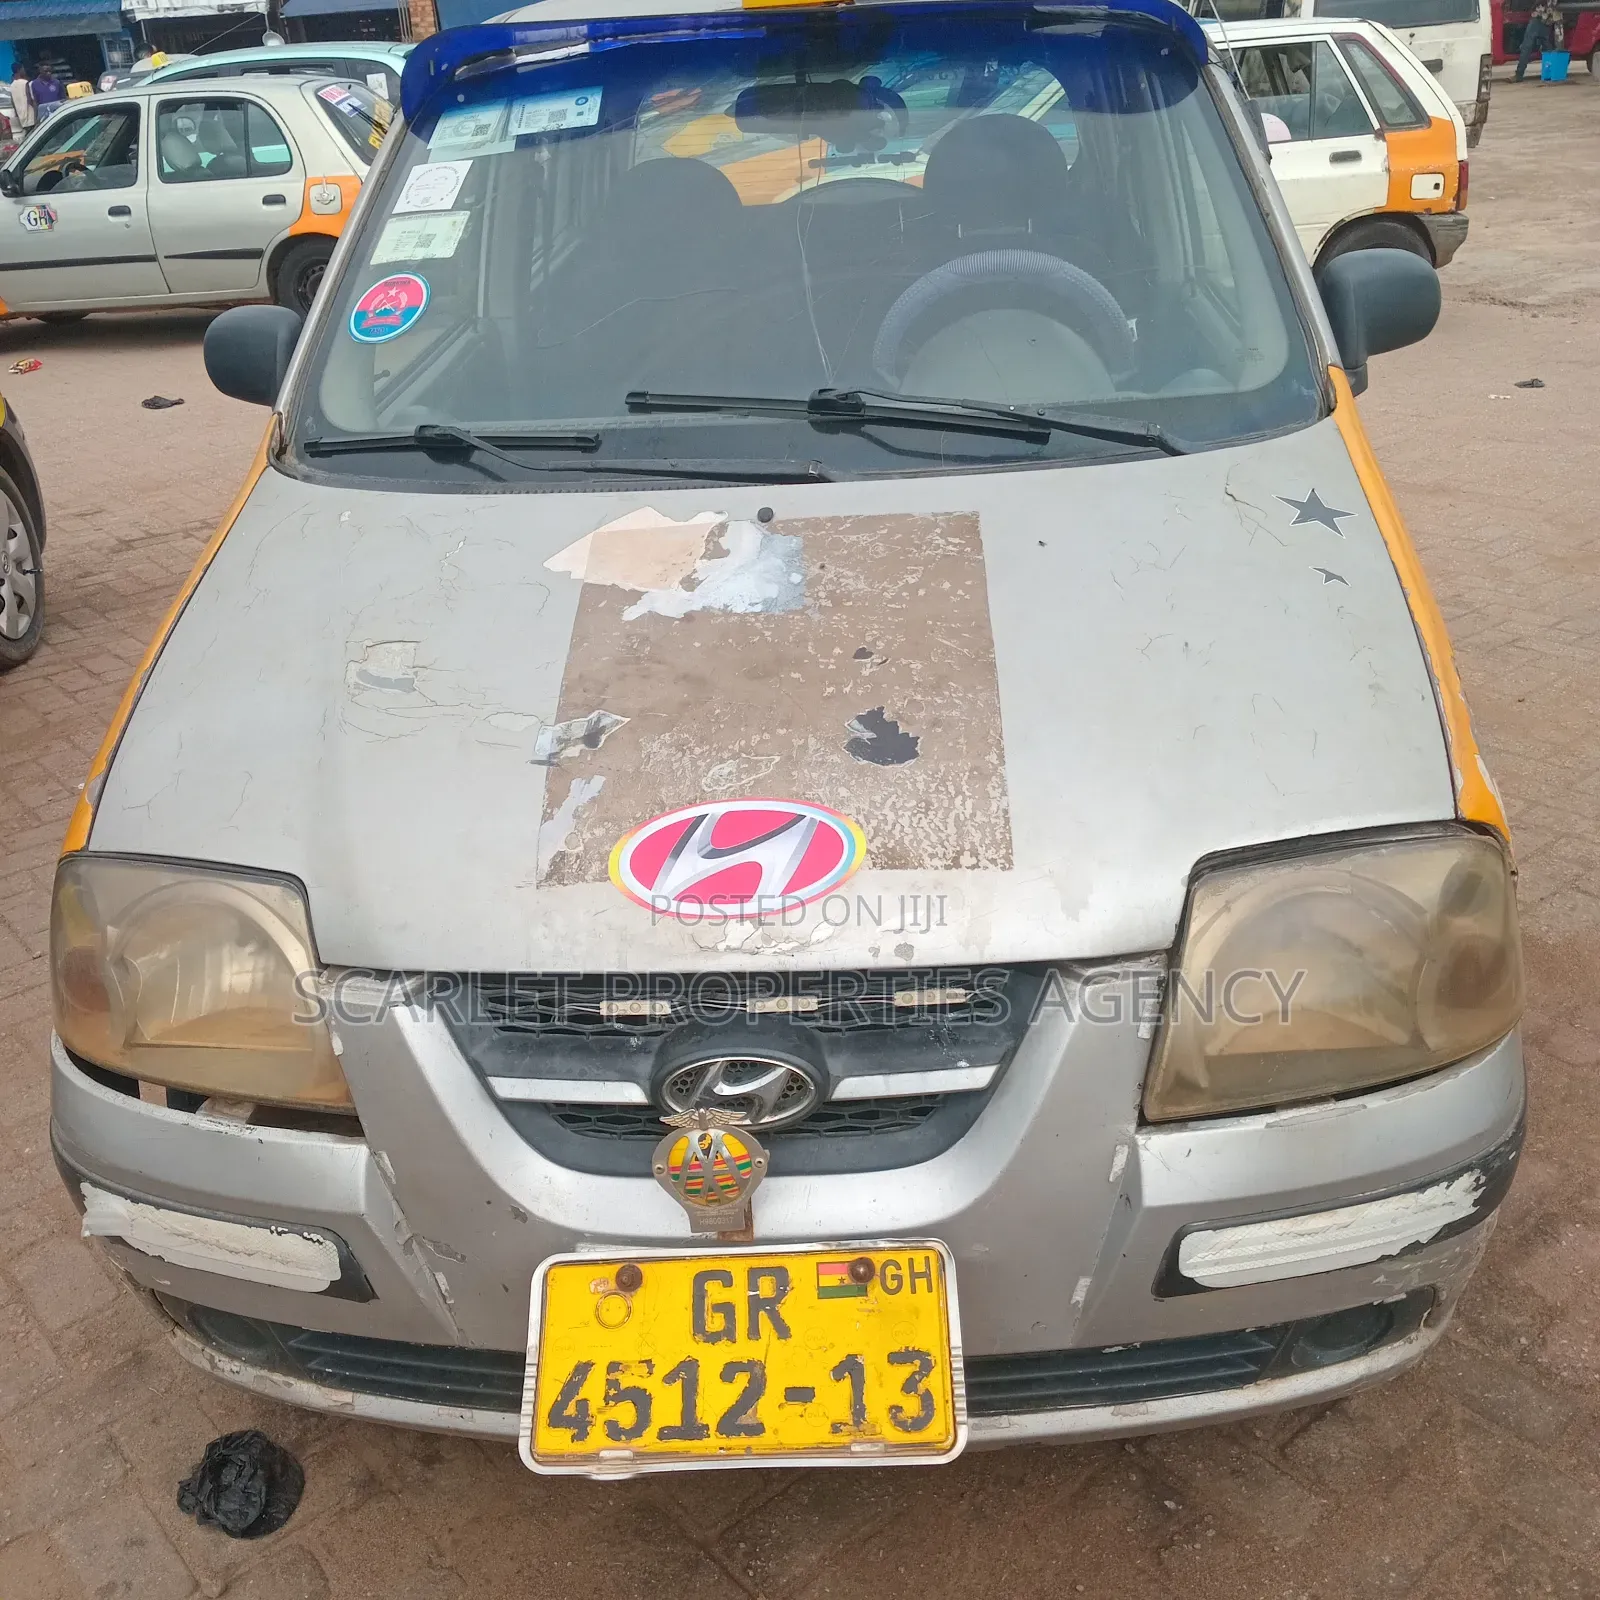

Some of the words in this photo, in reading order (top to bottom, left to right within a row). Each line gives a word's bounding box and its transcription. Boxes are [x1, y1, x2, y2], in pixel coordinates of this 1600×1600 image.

[691, 1265, 793, 1346] GR
[879, 1255, 933, 1296] GH
[547, 1346, 936, 1443] 4512-13
